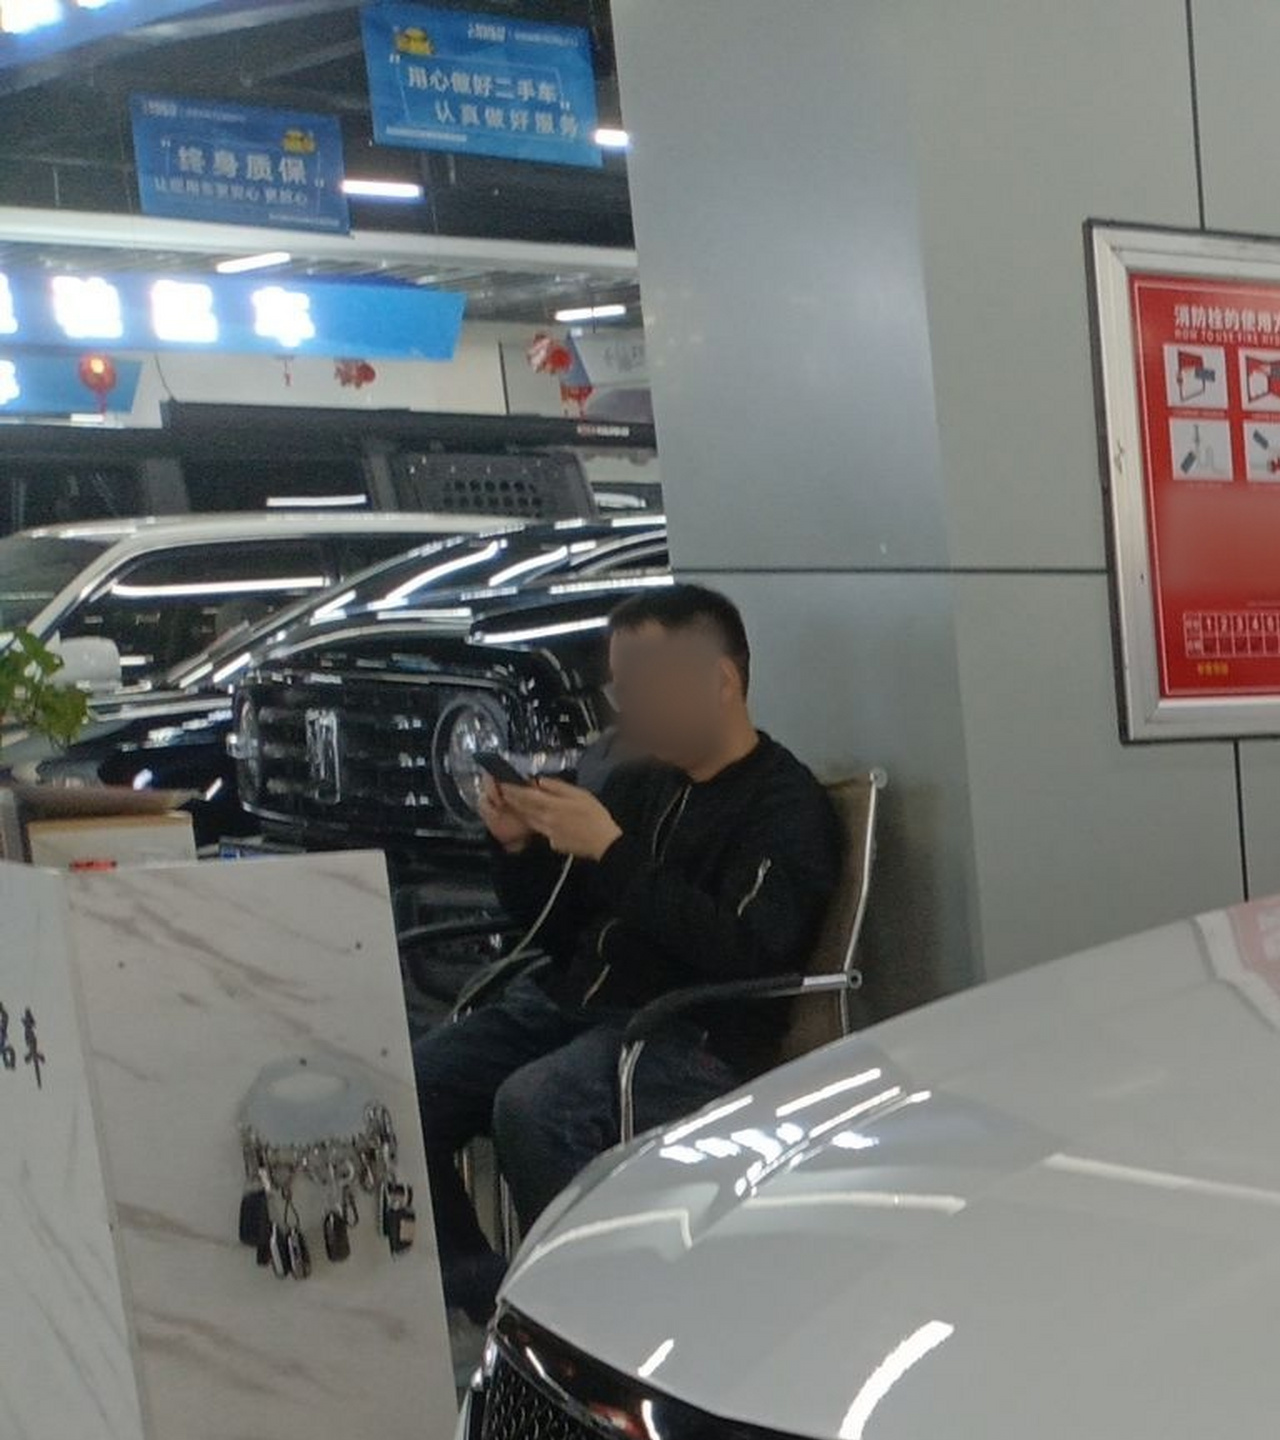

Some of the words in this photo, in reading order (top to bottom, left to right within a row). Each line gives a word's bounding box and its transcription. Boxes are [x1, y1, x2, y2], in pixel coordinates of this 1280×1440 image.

[408, 66, 557, 103] 用心做好二手车
[435, 99, 579, 138] 认真做好服务
[178, 146, 306, 186] 终身质保
